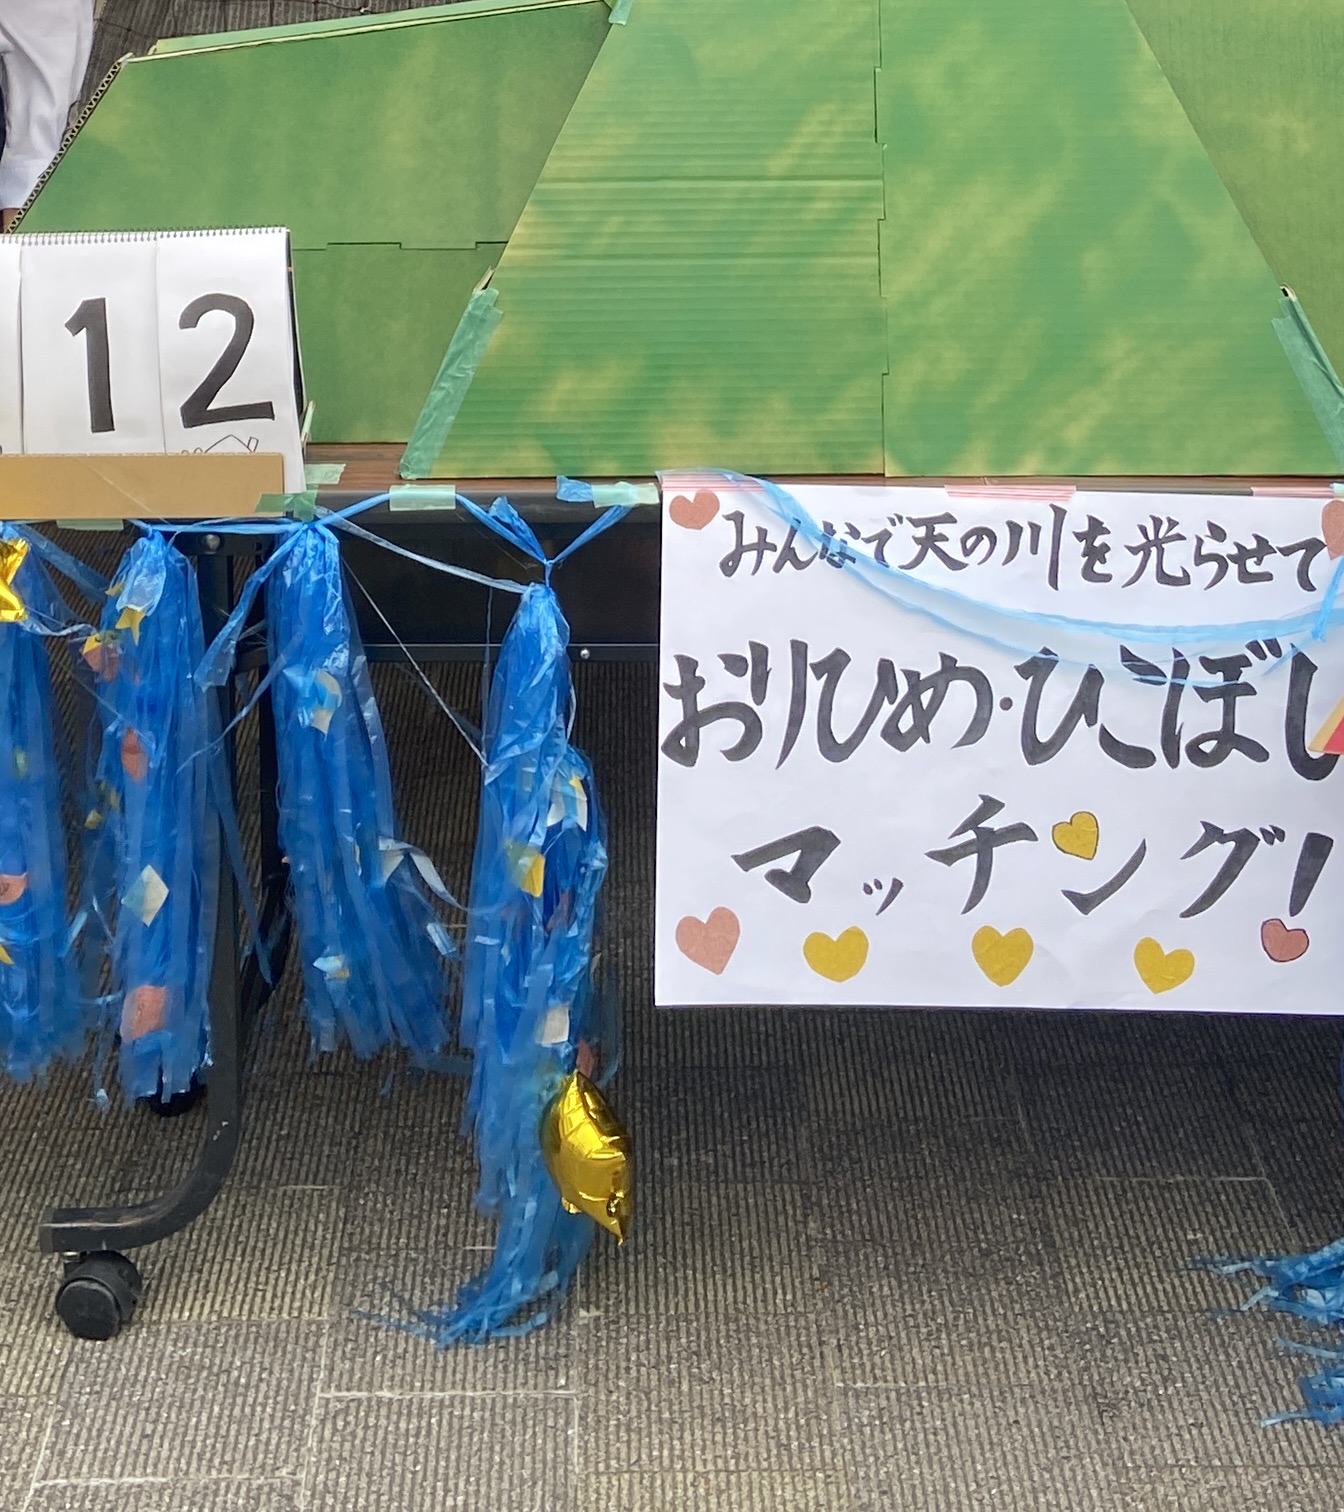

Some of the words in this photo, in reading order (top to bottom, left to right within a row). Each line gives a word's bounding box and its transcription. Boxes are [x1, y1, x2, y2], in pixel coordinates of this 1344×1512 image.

[719, 503, 1327, 591] みんなで天の川を光らせて
[660, 638, 1343, 781] おりひめ・ひこぼし
[732, 794, 1336, 920] マッチング!
